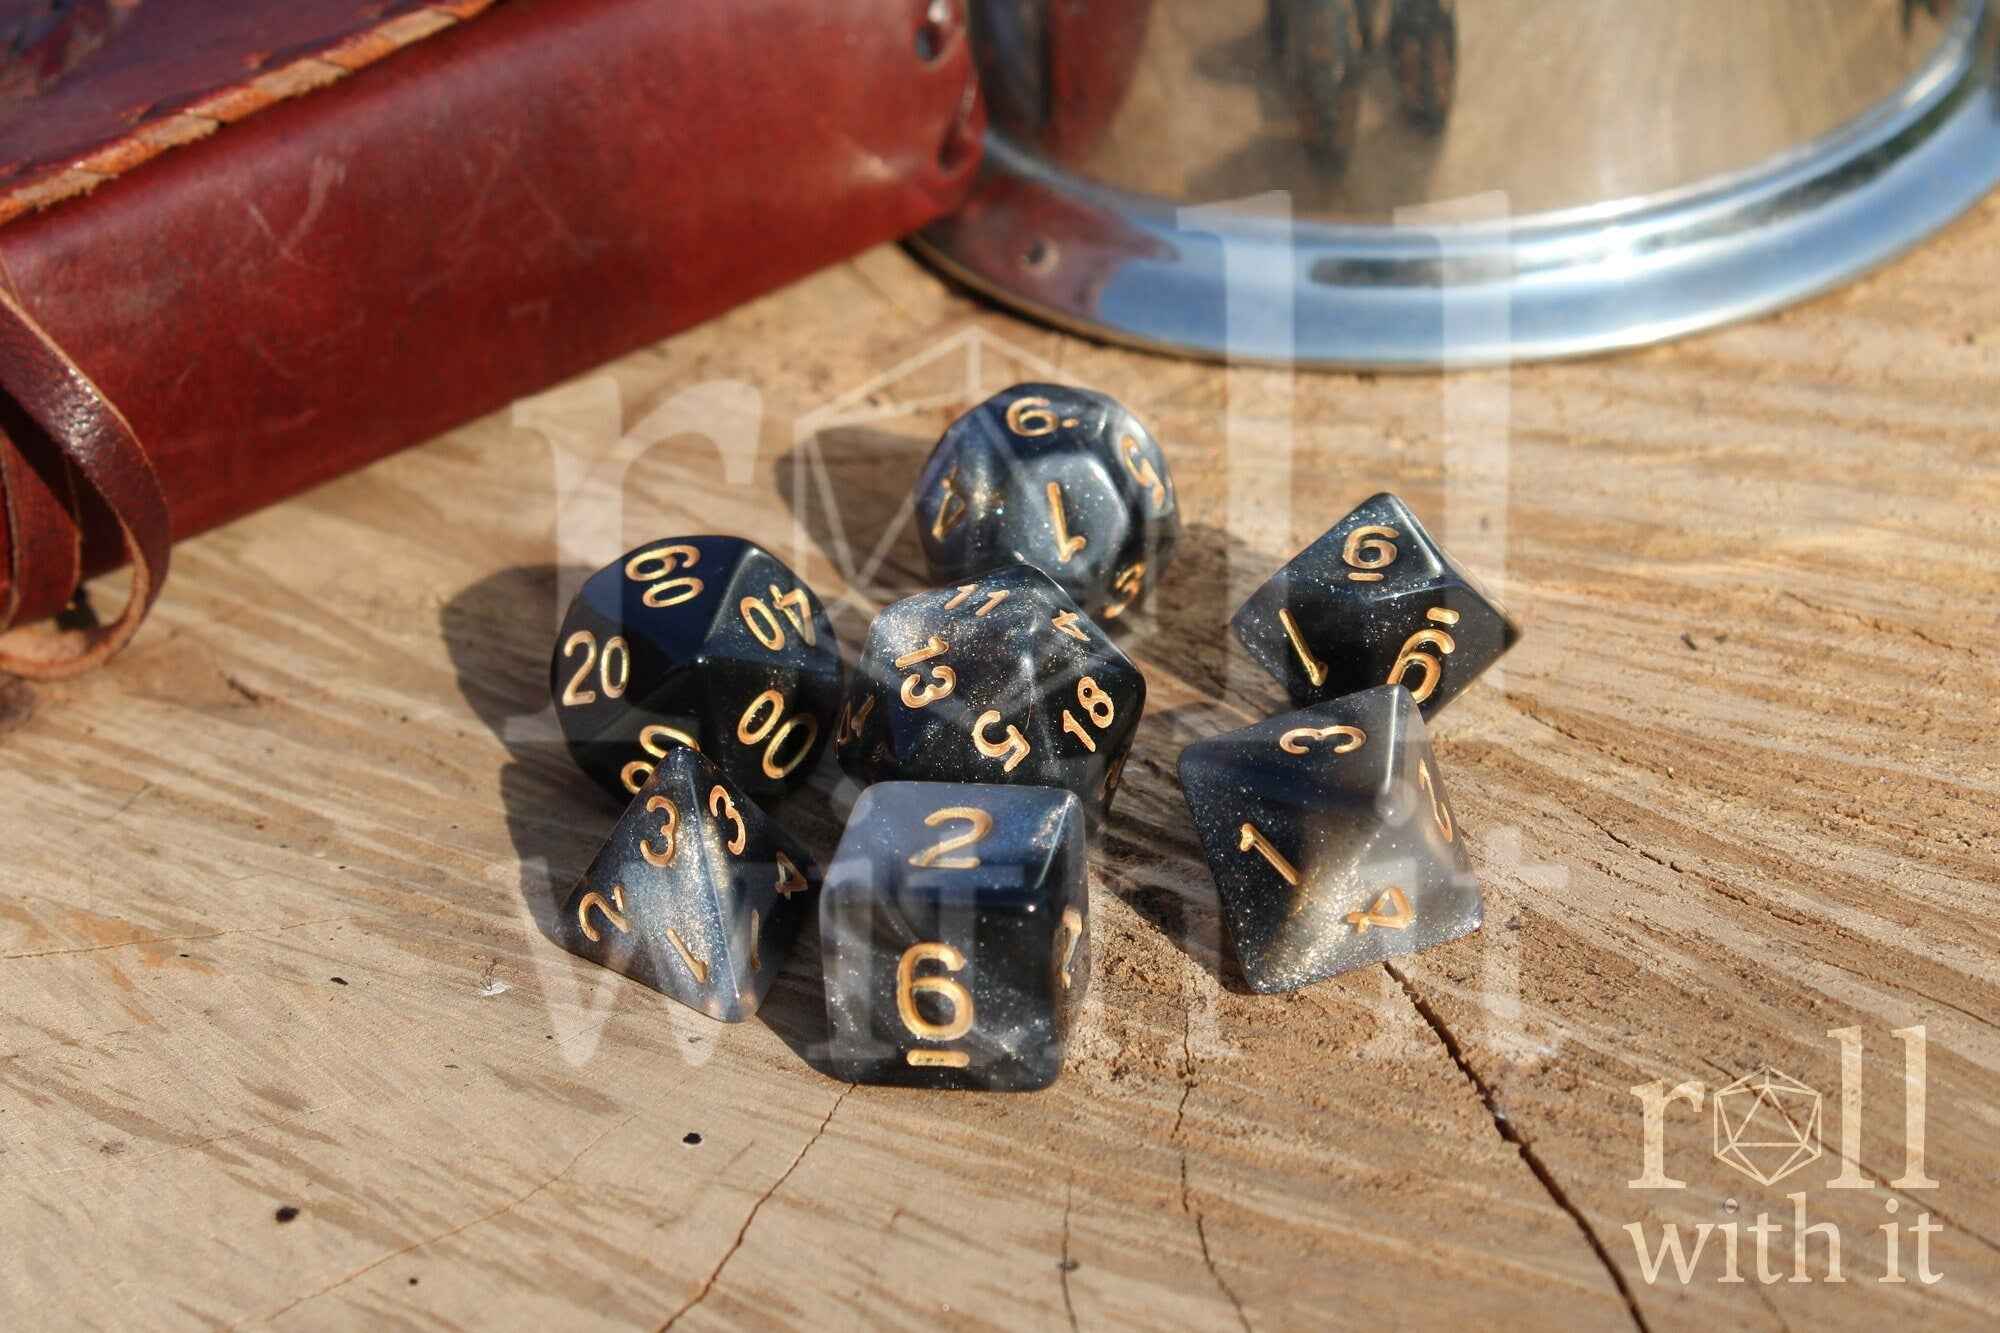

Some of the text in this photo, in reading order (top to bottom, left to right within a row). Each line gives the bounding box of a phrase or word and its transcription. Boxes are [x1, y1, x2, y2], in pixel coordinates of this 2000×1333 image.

[1046, 481, 1087, 564] 1
[740, 584, 816, 651] 40
[944, 584, 1009, 617] 11
[562, 630, 630, 706] 20
[895, 636, 957, 709] 13
[737, 689, 817, 780] 00
[972, 710, 1031, 772] 5
[1062, 676, 1114, 752] 18
[640, 795, 681, 867] 3
[709, 785, 746, 855] 3
[909, 806, 993, 869] 2
[1239, 822, 1300, 886] 1
[666, 927, 708, 983] 1
